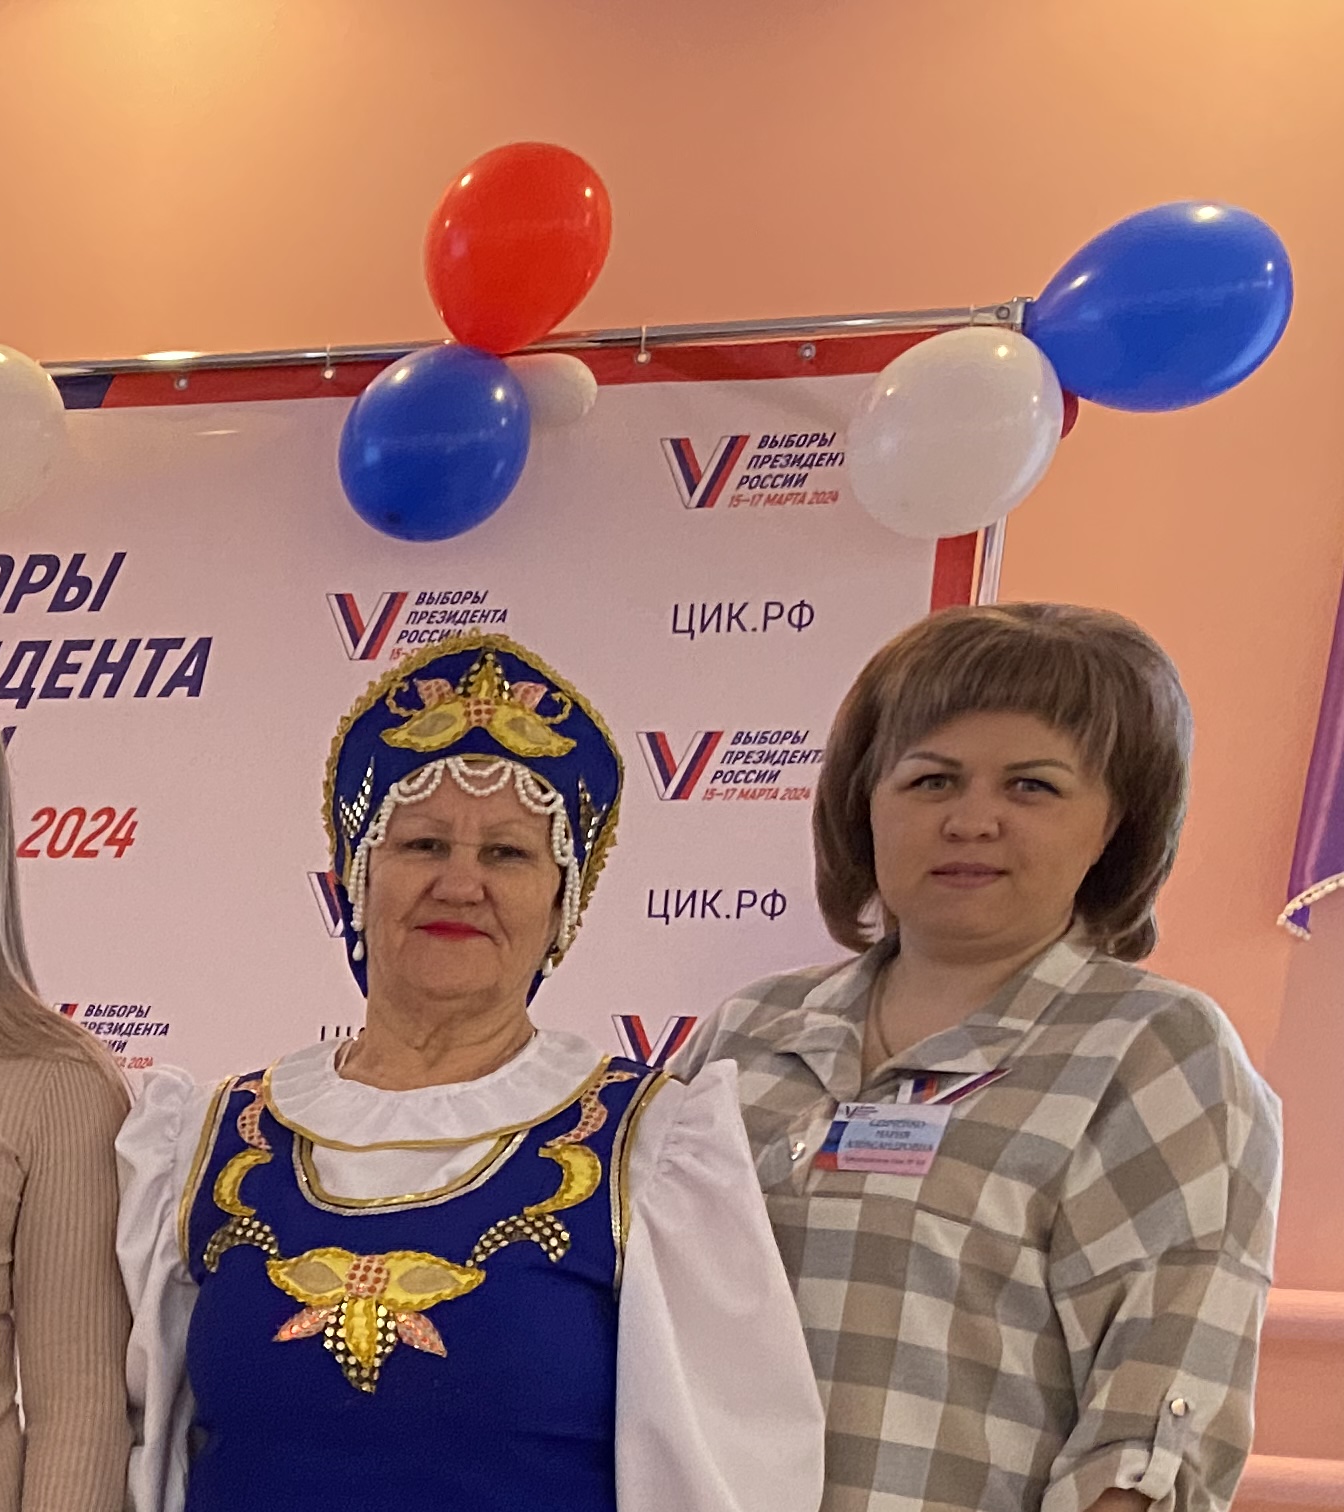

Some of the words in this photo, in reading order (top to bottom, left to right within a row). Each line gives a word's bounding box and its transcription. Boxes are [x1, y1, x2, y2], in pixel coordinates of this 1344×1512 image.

[757, 432, 836, 449] ВЫБОРЫ
[736, 473, 808, 490] РОССИИ
[763, 492, 807, 506] МАРТА
[415, 590, 489, 605] ВЫБОРЫ
[405, 608, 508, 626] ПРЕЗИДЕНТА
[672, 599, 815, 640] ЦИК.РФ
[731, 730, 809, 746] ВЫБОРЫ
[720, 749, 824, 766] ПРЕЗИДЕНТ
[710, 769, 781, 784] РОССИИ
[736, 788, 779, 800] МАРТА
[780, 787, 811, 801] 2024
[16, 807, 138, 858] 2024
[648, 888, 787, 925] ЦИК.РФ
[84, 1004, 151, 1018] ВЫБОРЫ
